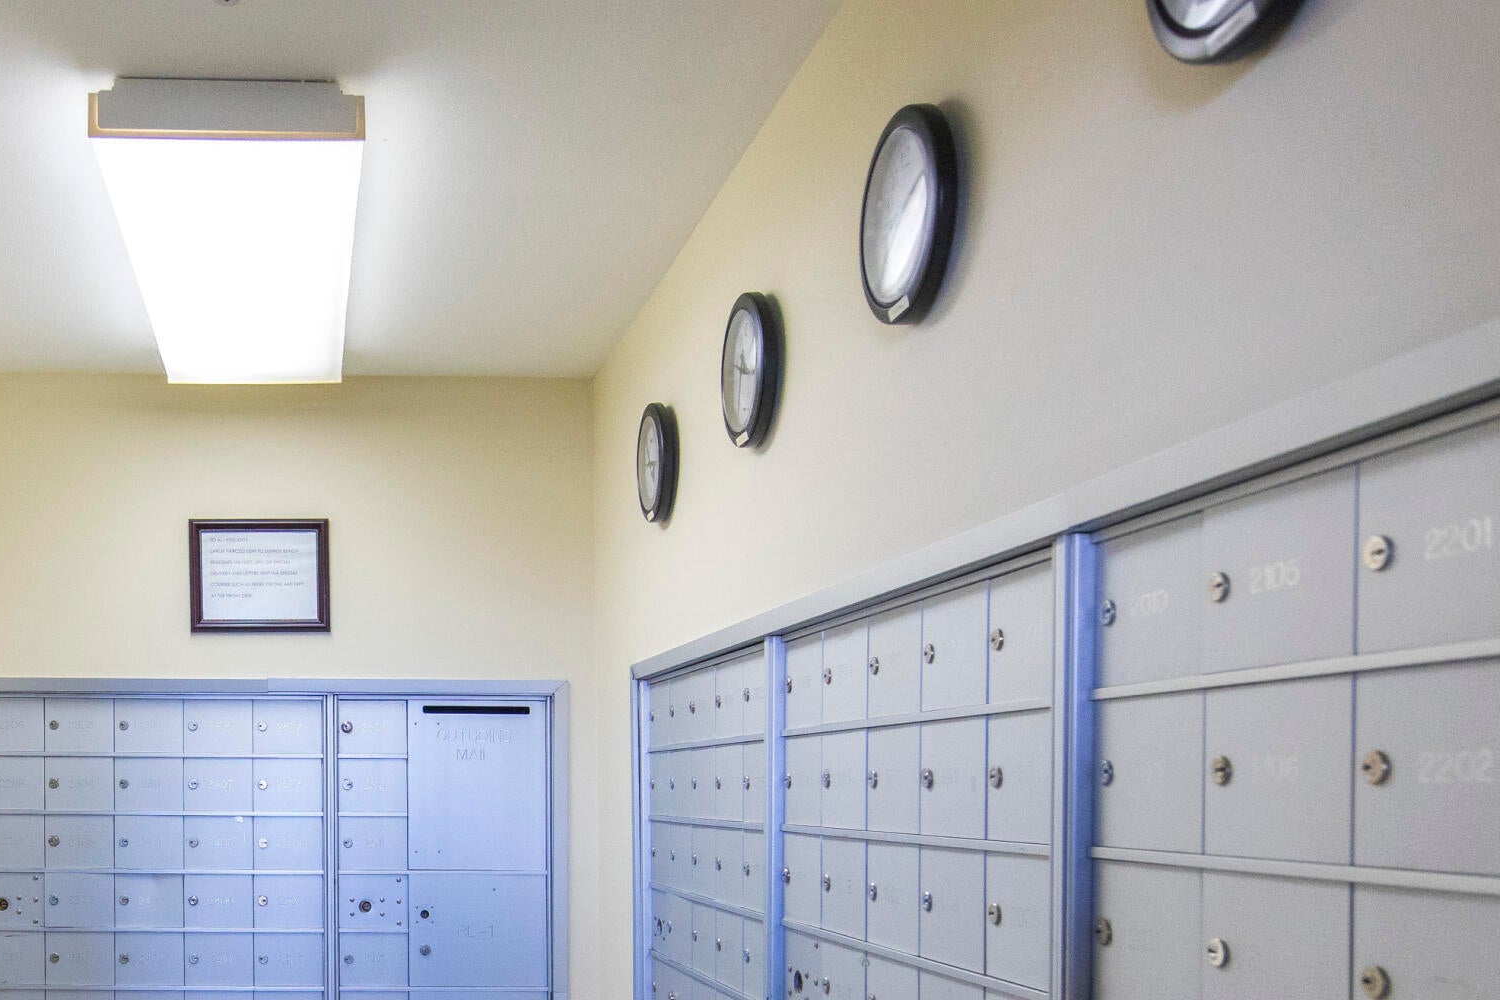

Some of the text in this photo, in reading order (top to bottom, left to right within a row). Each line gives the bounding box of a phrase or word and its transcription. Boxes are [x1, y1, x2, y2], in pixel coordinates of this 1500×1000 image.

[1423, 517, 1493, 561] 2201
[1249, 559, 1301, 594] 2105
[1418, 749, 1493, 784] 2202
